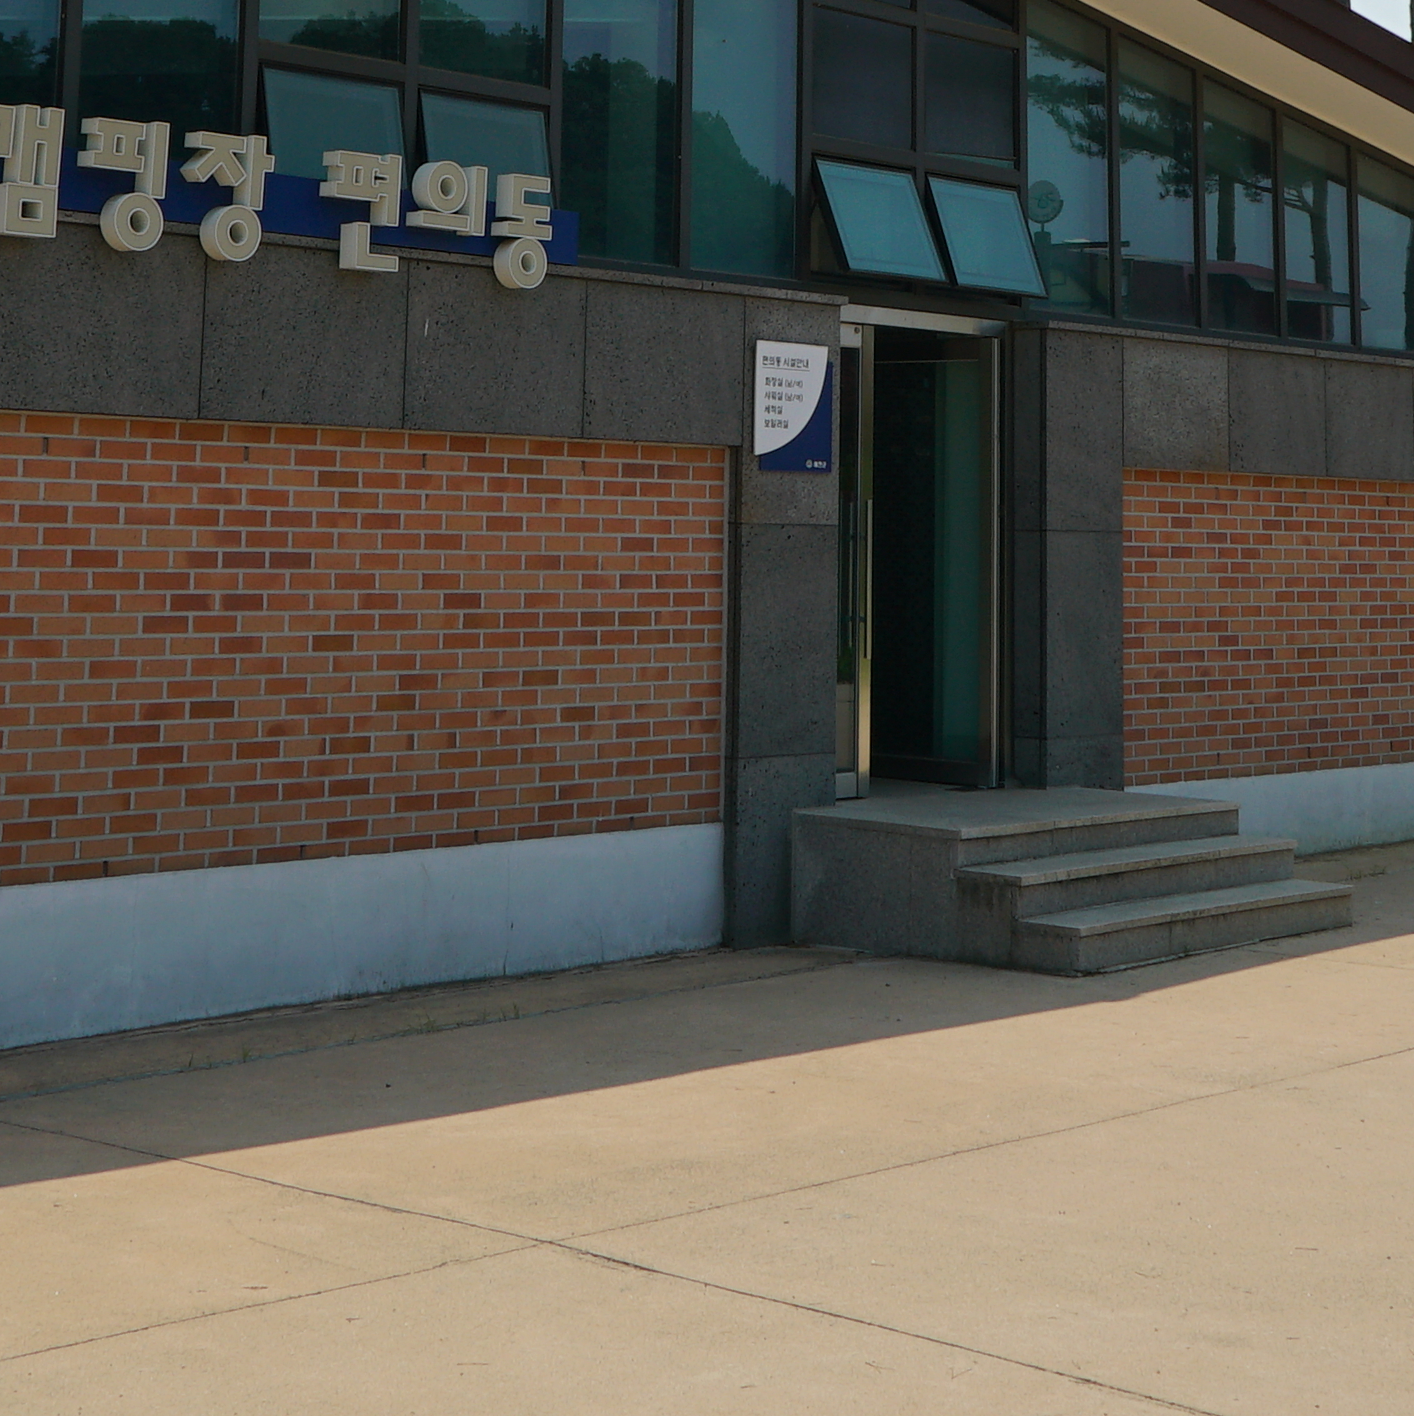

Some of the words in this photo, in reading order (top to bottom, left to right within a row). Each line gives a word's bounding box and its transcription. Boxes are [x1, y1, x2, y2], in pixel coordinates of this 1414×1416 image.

[319, 149, 553, 290] 편의동
[762, 355, 781, 367] 편의동
[783, 357, 809, 368] 시설안내
[765, 376, 783, 387] 화장실
[764, 418, 789, 429] 보일러실
